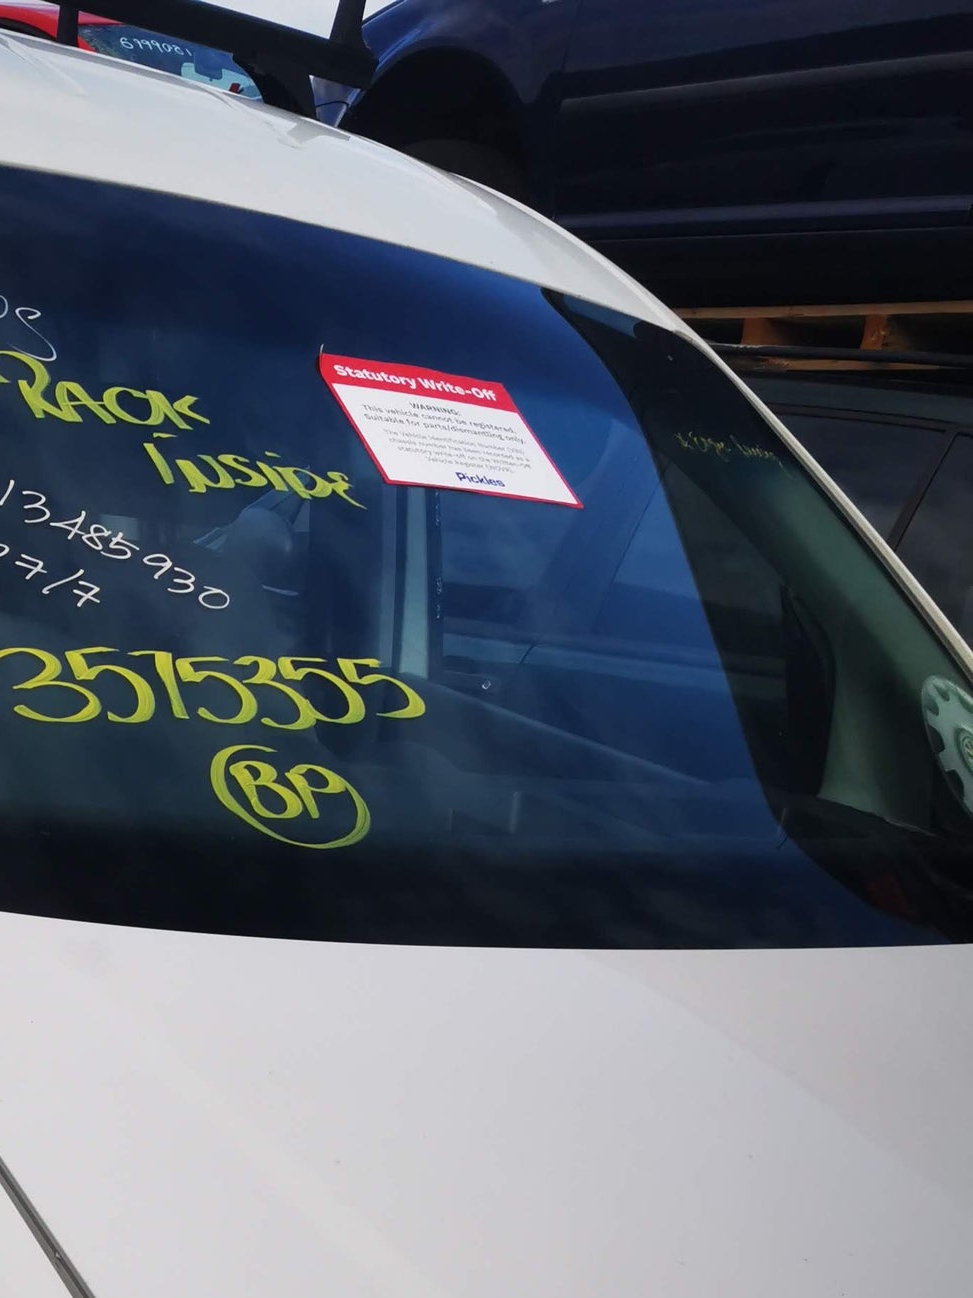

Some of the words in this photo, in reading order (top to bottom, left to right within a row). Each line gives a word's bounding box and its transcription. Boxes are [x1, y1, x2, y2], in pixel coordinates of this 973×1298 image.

[333, 364, 417, 390] Statutory
[418, 377, 497, 401] Write-Off
[362, 404, 384, 413] This
[385, 407, 420, 419] vehicle
[421, 413, 454, 424] cannot
[455, 417, 468, 425] be
[409, 402, 461, 416] WARNING:
[364, 413, 405, 425] Suitable
[406, 418, 421, 427] for
[455, 471, 506, 487] Pickles
[228, 760, 347, 820] BP
